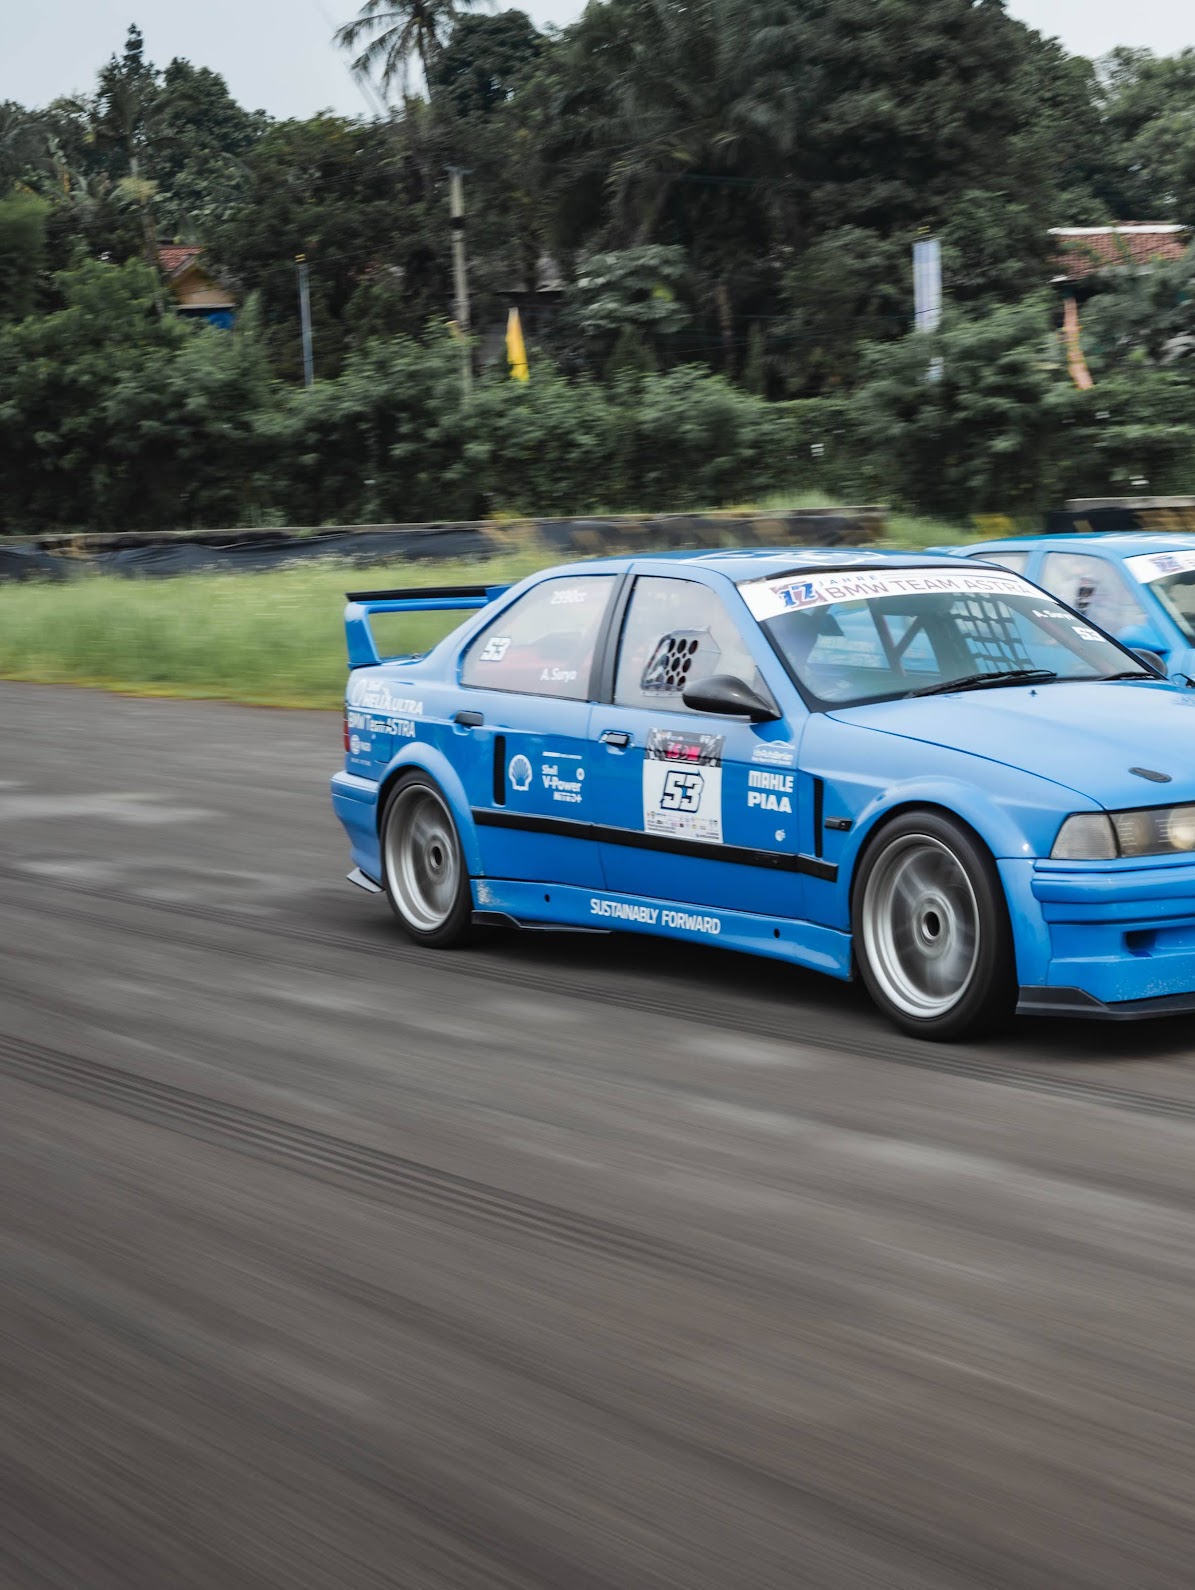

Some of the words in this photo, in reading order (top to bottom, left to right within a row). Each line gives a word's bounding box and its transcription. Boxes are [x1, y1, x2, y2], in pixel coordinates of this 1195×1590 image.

[825, 581, 890, 599] BMW
[889, 579, 961, 591] TEAM
[963, 579, 1034, 595] ASTRA
[480, 636, 511, 662] 53
[392, 697, 424, 715] ULTRA
[385, 718, 416, 738] ASTRA
[541, 775, 583, 793] V-Power
[660, 769, 705, 814] 53
[747, 769, 795, 793] MAHLE
[747, 790, 793, 814] PIAA
[589, 898, 659, 925] SUSTAINABLY
[661, 910, 722, 935] FORWARD
